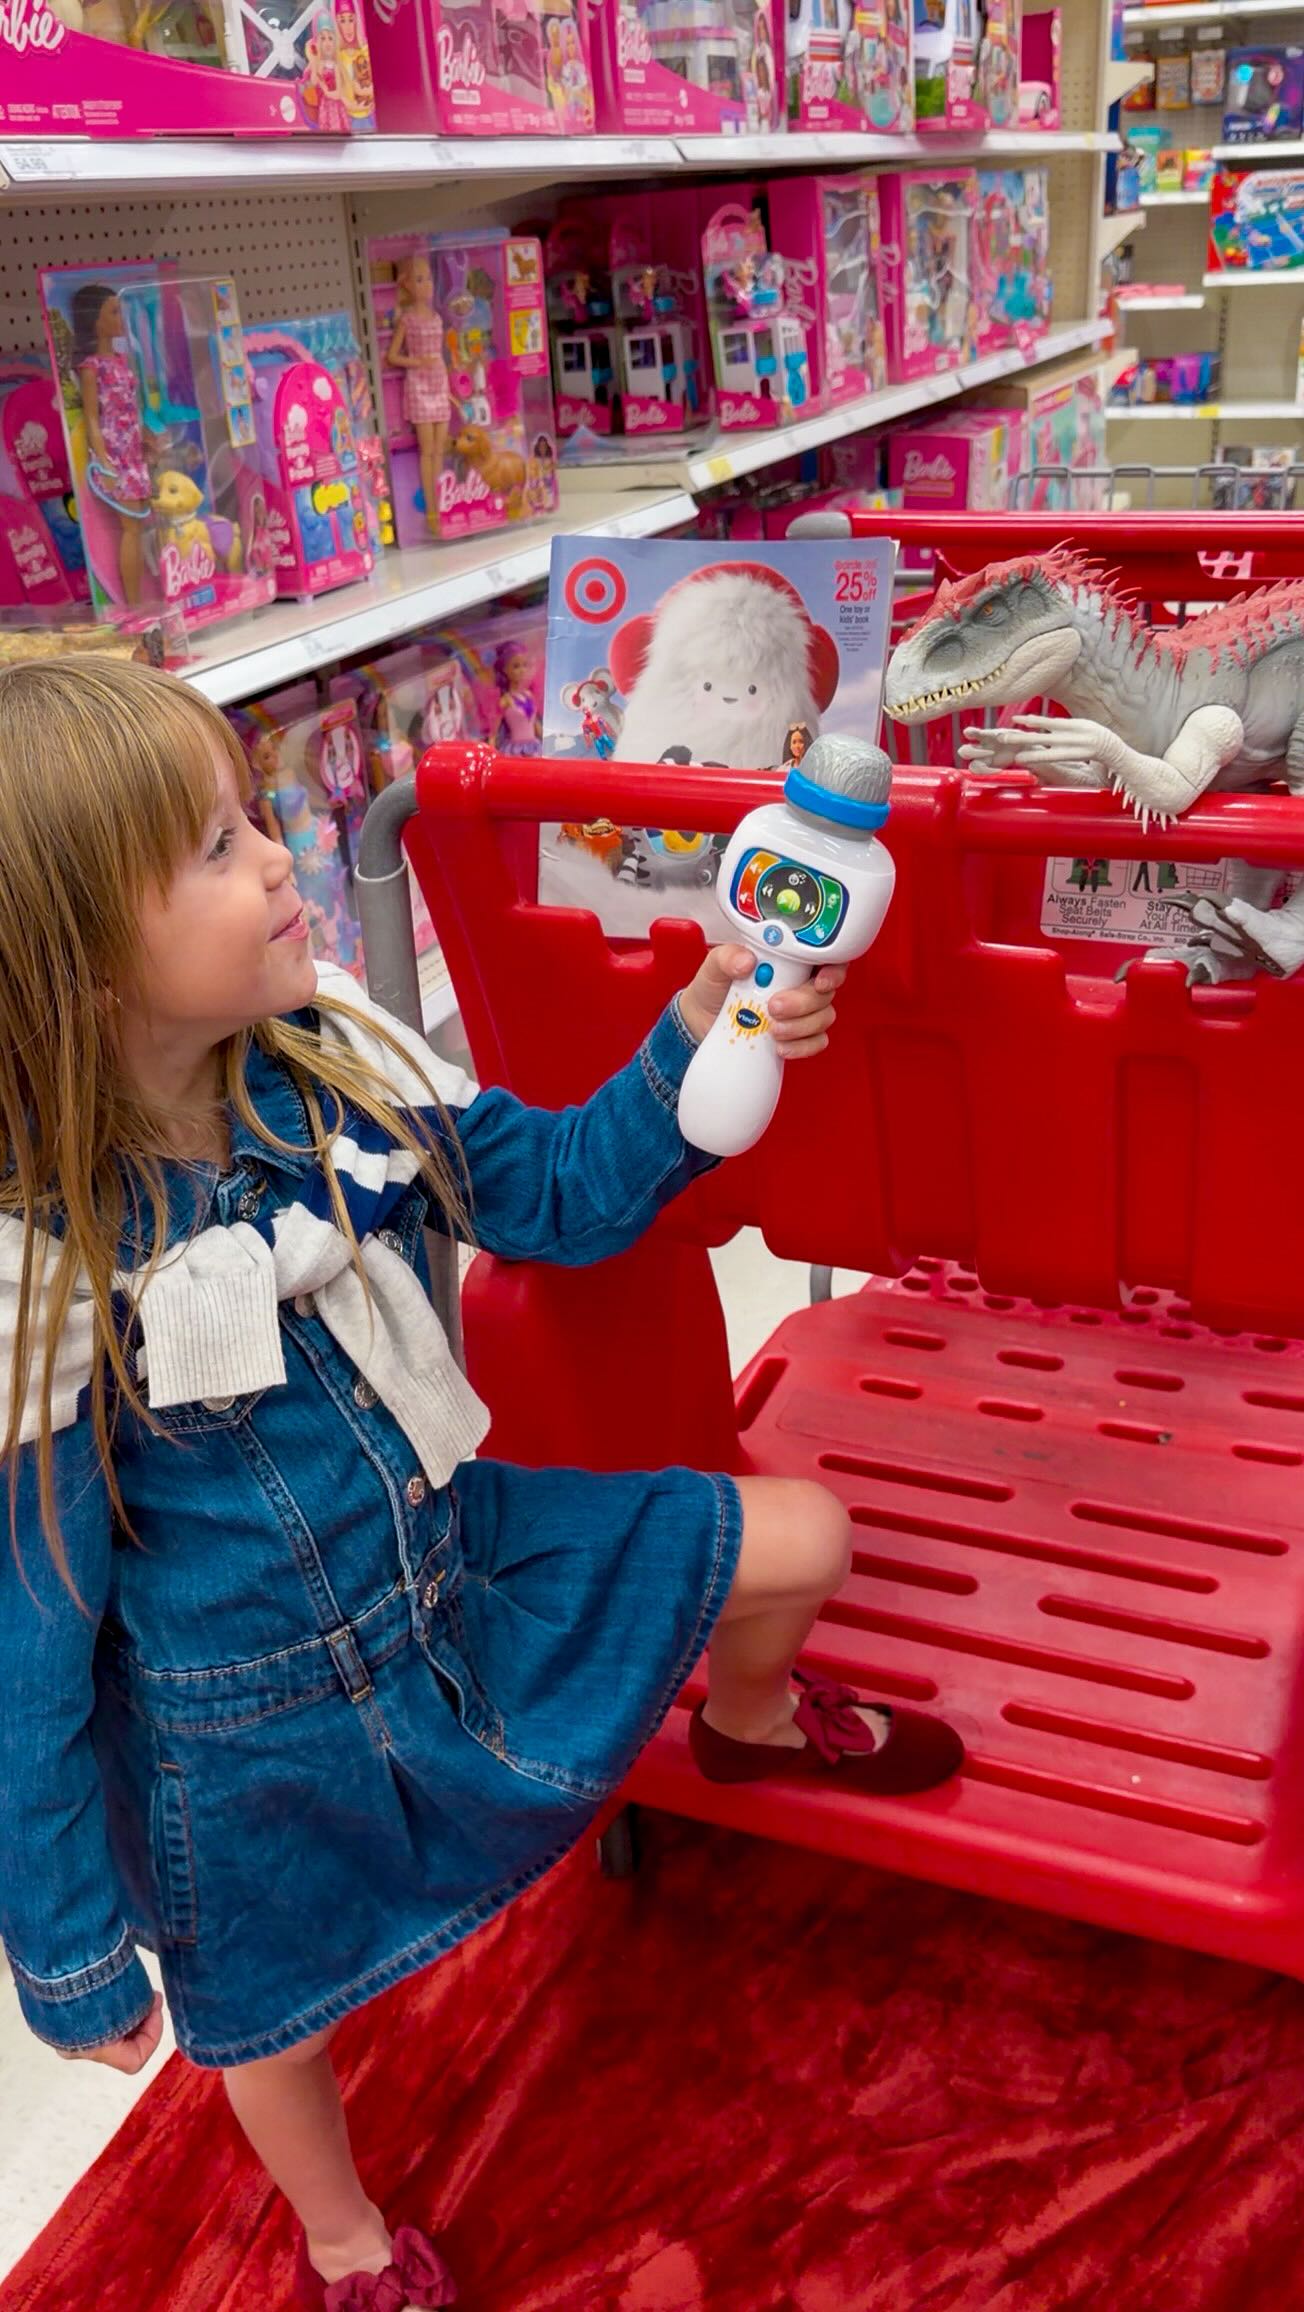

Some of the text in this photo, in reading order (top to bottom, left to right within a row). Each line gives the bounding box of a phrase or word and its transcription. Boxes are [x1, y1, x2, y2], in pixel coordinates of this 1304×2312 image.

[437, 28, 486, 91] Barbie
[904, 450, 956, 482] Barbie
[439, 469, 490, 512] Barbie
[162, 543, 215, 596] Barbie
[863, 588, 877, 601] off
[840, 605, 852, 614] One
[853, 605, 863, 615] toy
[855, 615, 869, 624] book
[1046, 894, 1127, 909] Always Fasten
[1147, 901, 1172, 914] Stay
[1058, 905, 1112, 917] Seat Belts
[1145, 911, 1170, 922] Your
[1061, 914, 1108, 929] Securely
[1139, 920, 1151, 930] At
[1153, 921, 1168, 931] All
